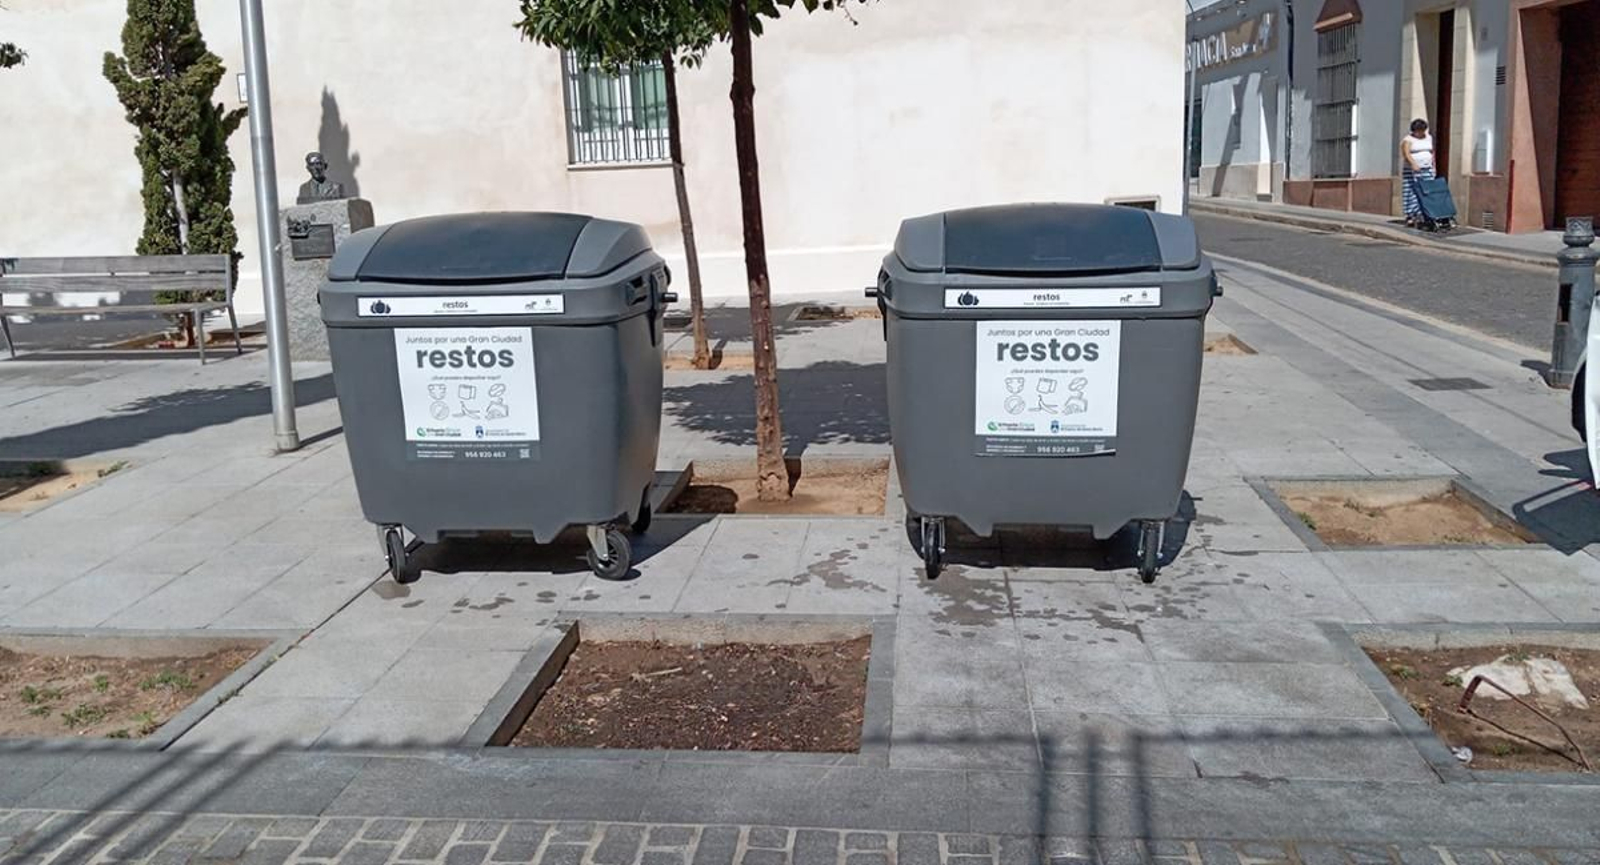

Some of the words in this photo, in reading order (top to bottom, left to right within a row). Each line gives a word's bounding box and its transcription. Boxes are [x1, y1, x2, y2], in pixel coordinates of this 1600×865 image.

[1033, 292, 1061, 301] restos
[442, 299, 469, 309] restos
[1054, 328, 1076, 336] Gran
[1077, 328, 1110, 336] Ciudad
[405, 336, 433, 344] Juntos
[434, 337, 448, 345] por
[468, 335, 490, 343] Gran
[491, 334, 522, 343] Ciudad
[997, 338, 1099, 362] restos
[416, 345, 514, 369] restos
